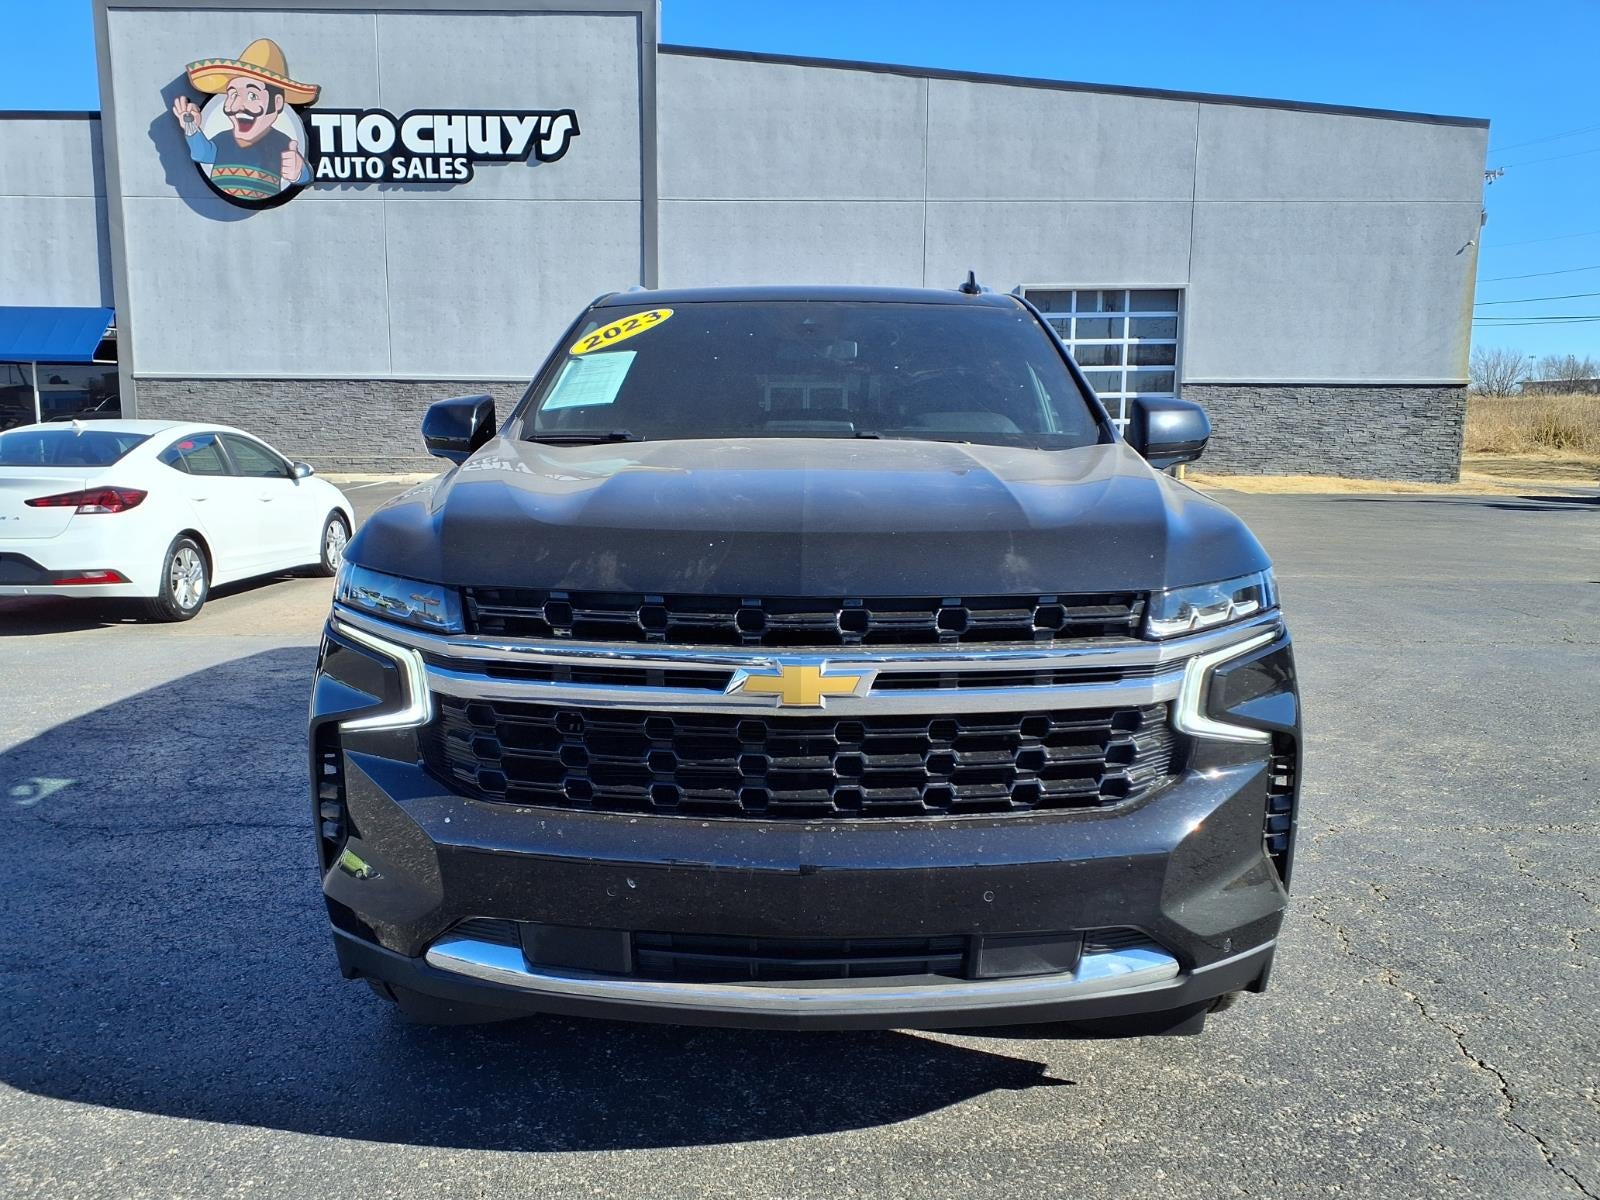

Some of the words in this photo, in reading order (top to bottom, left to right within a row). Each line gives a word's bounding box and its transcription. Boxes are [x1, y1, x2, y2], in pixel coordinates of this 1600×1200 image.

[311, 114, 396, 154] TIO
[401, 114, 573, 155] CHUY'S
[316, 156, 385, 179] AUTO
[391, 156, 469, 179] SALES
[583, 311, 662, 351] 2023
